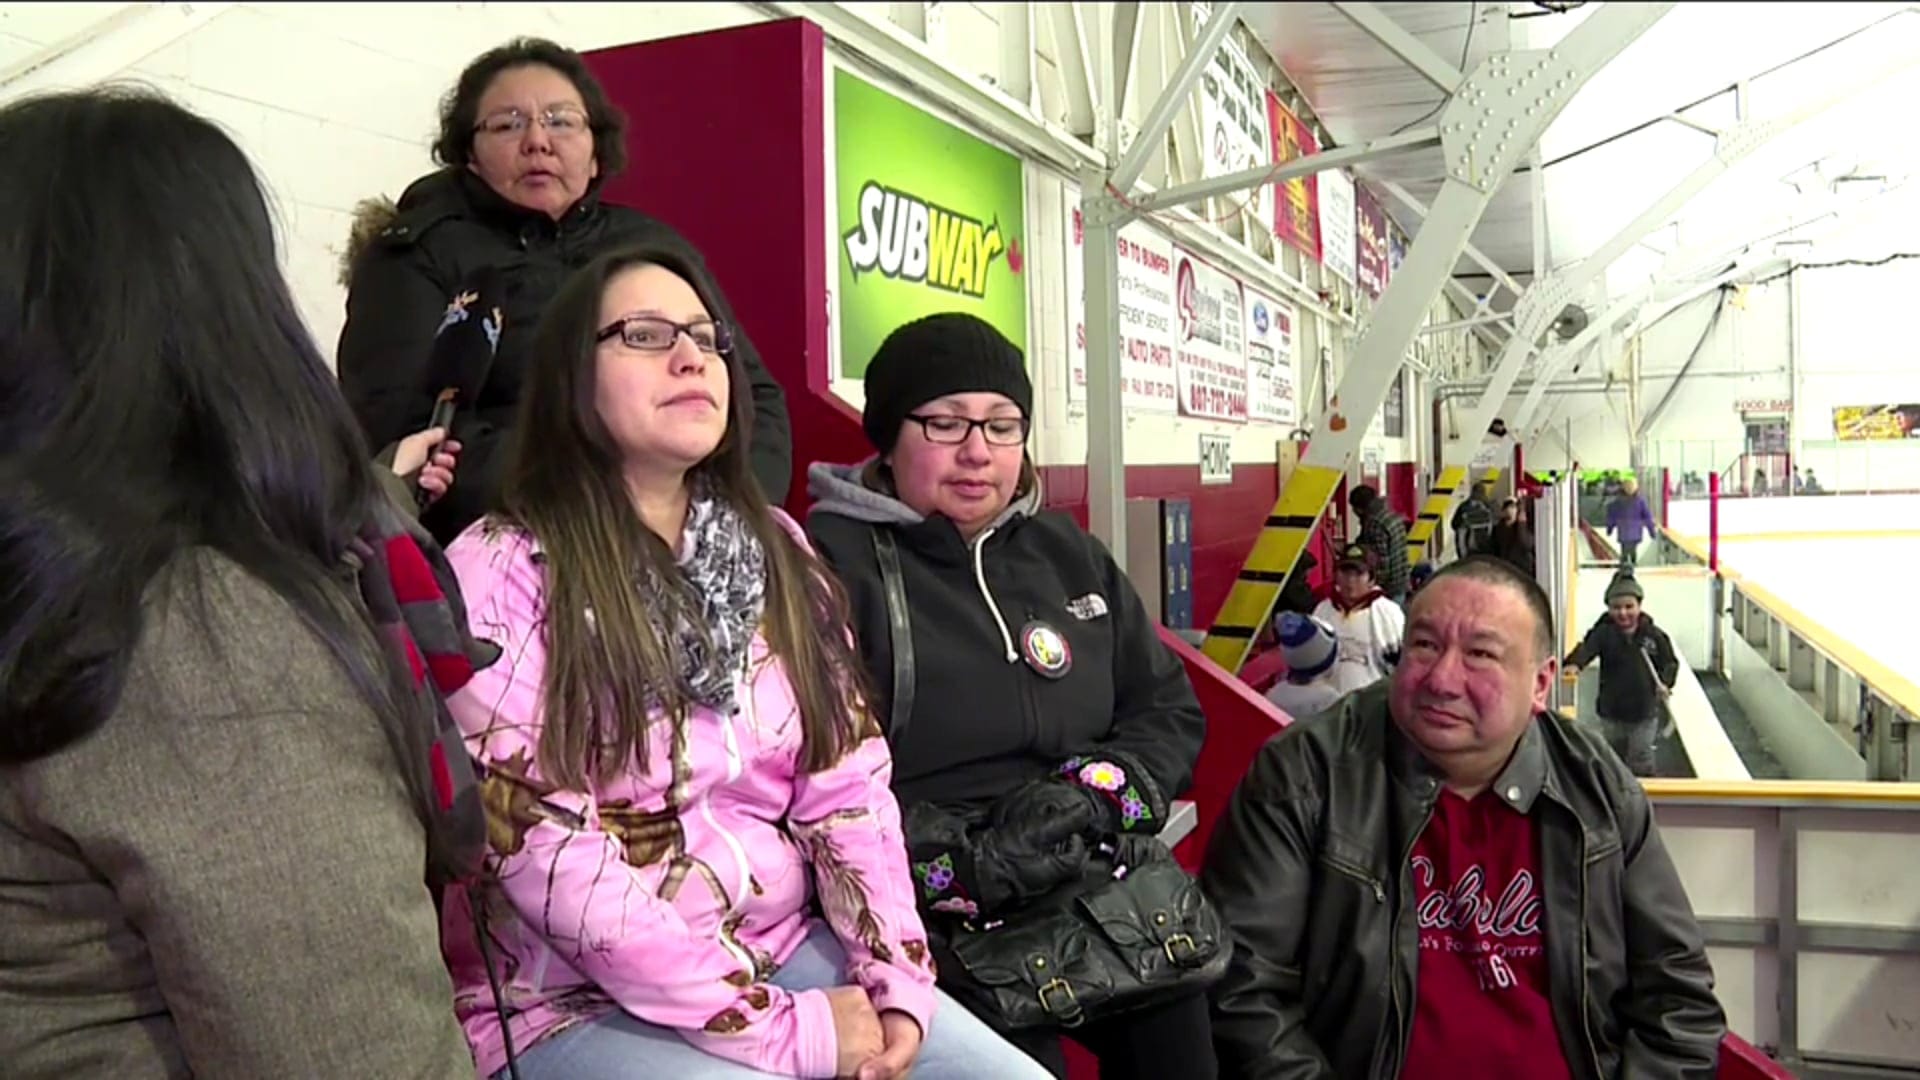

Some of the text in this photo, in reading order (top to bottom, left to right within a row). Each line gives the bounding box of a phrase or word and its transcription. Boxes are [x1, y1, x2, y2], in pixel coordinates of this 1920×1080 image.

[843, 180, 1004, 299] SUBWAY
[1127, 337, 1148, 363] AUTO
[1200, 440, 1231, 474] HOME
